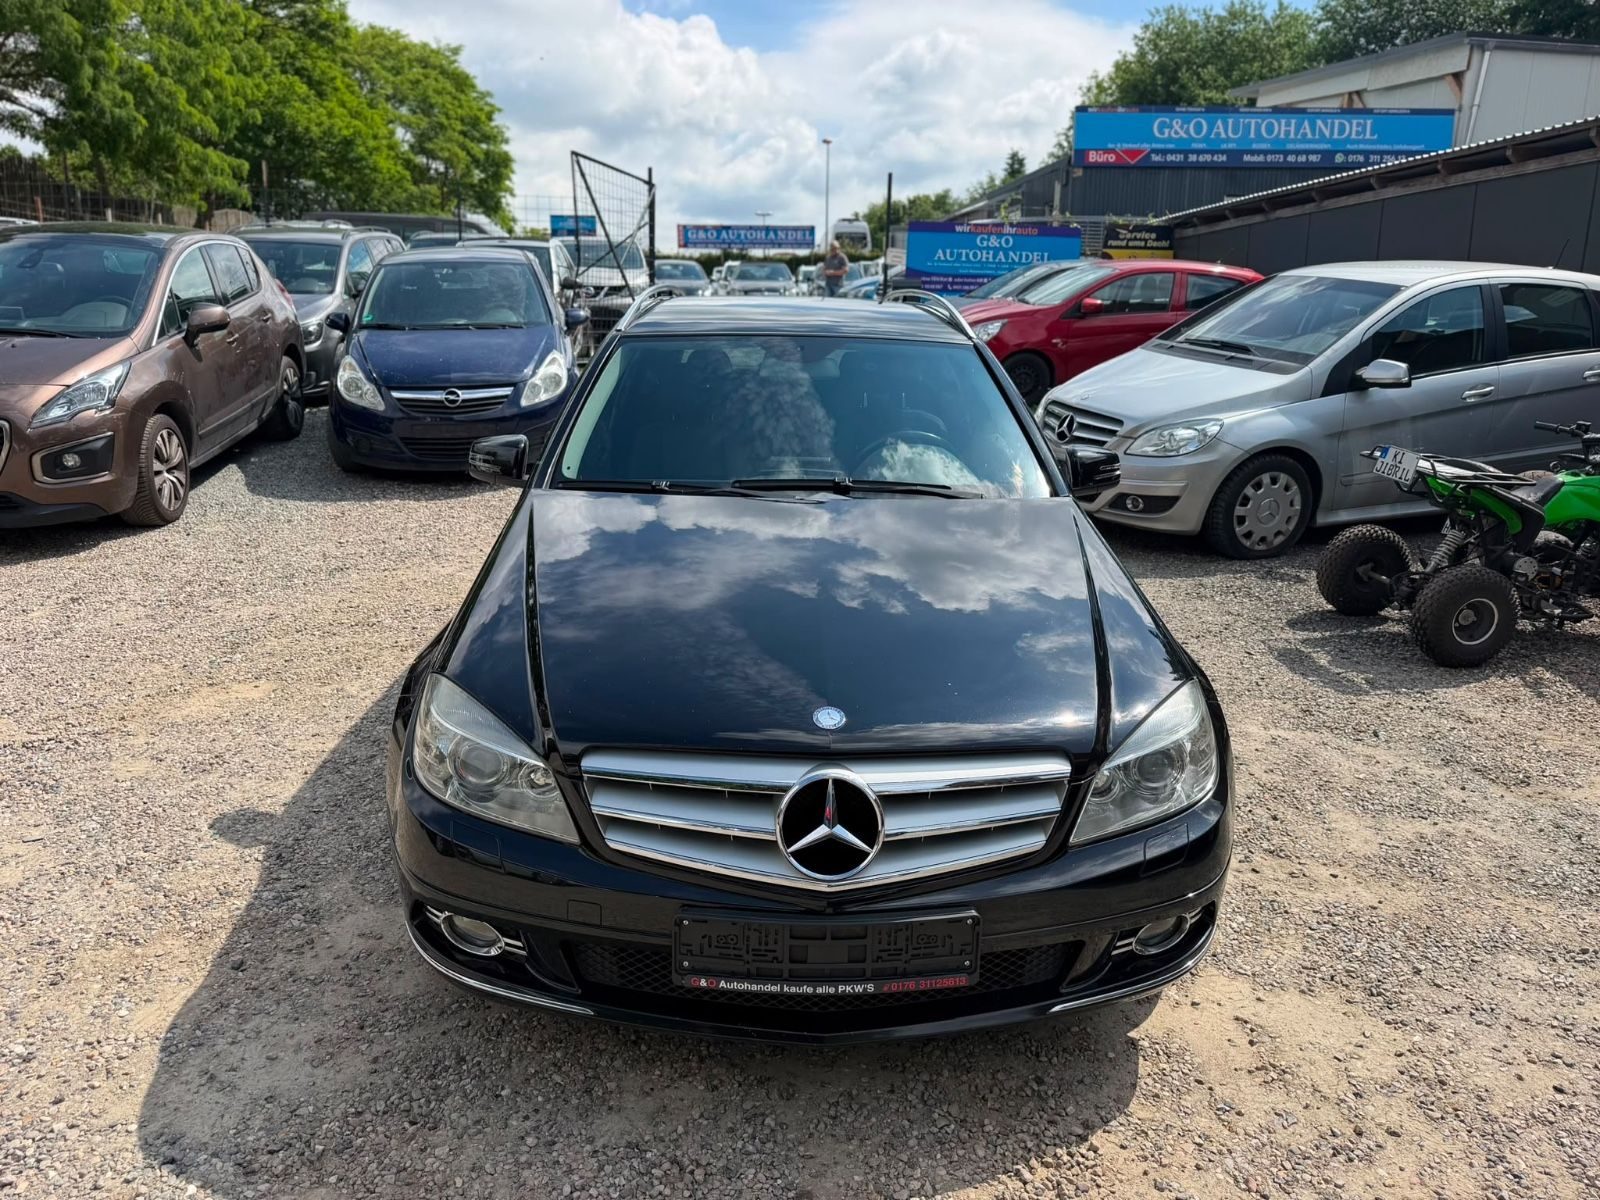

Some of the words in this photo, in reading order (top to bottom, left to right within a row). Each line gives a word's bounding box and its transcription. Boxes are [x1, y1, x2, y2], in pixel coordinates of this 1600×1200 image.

[1153, 117, 1208, 139] G&O
[1210, 118, 1378, 140] AUTOHANDEL
[1088, 151, 1116, 163] Büro
[1151, 153, 1165, 162] Tel.:
[1166, 153, 1184, 162] 0431
[1243, 153, 1265, 162] Mobil:
[1266, 153, 1284, 162] 0173
[687, 229, 717, 240] G&O
[719, 229, 813, 240] AUTOHANDEL
[954, 223, 1039, 236] wirkaufenihrauto
[976, 234, 1013, 248] G&O
[1391, 450, 1405, 465] KI
[1375, 460, 1410, 483] JIBRIL
[691, 977, 716, 987] G&O
[719, 980, 780, 992] Autohandel
[783, 984, 813, 994] kaufe
[816, 984, 835, 994] alle
[838, 983, 874, 994] PKW'S
[891, 981, 916, 991] 0176
